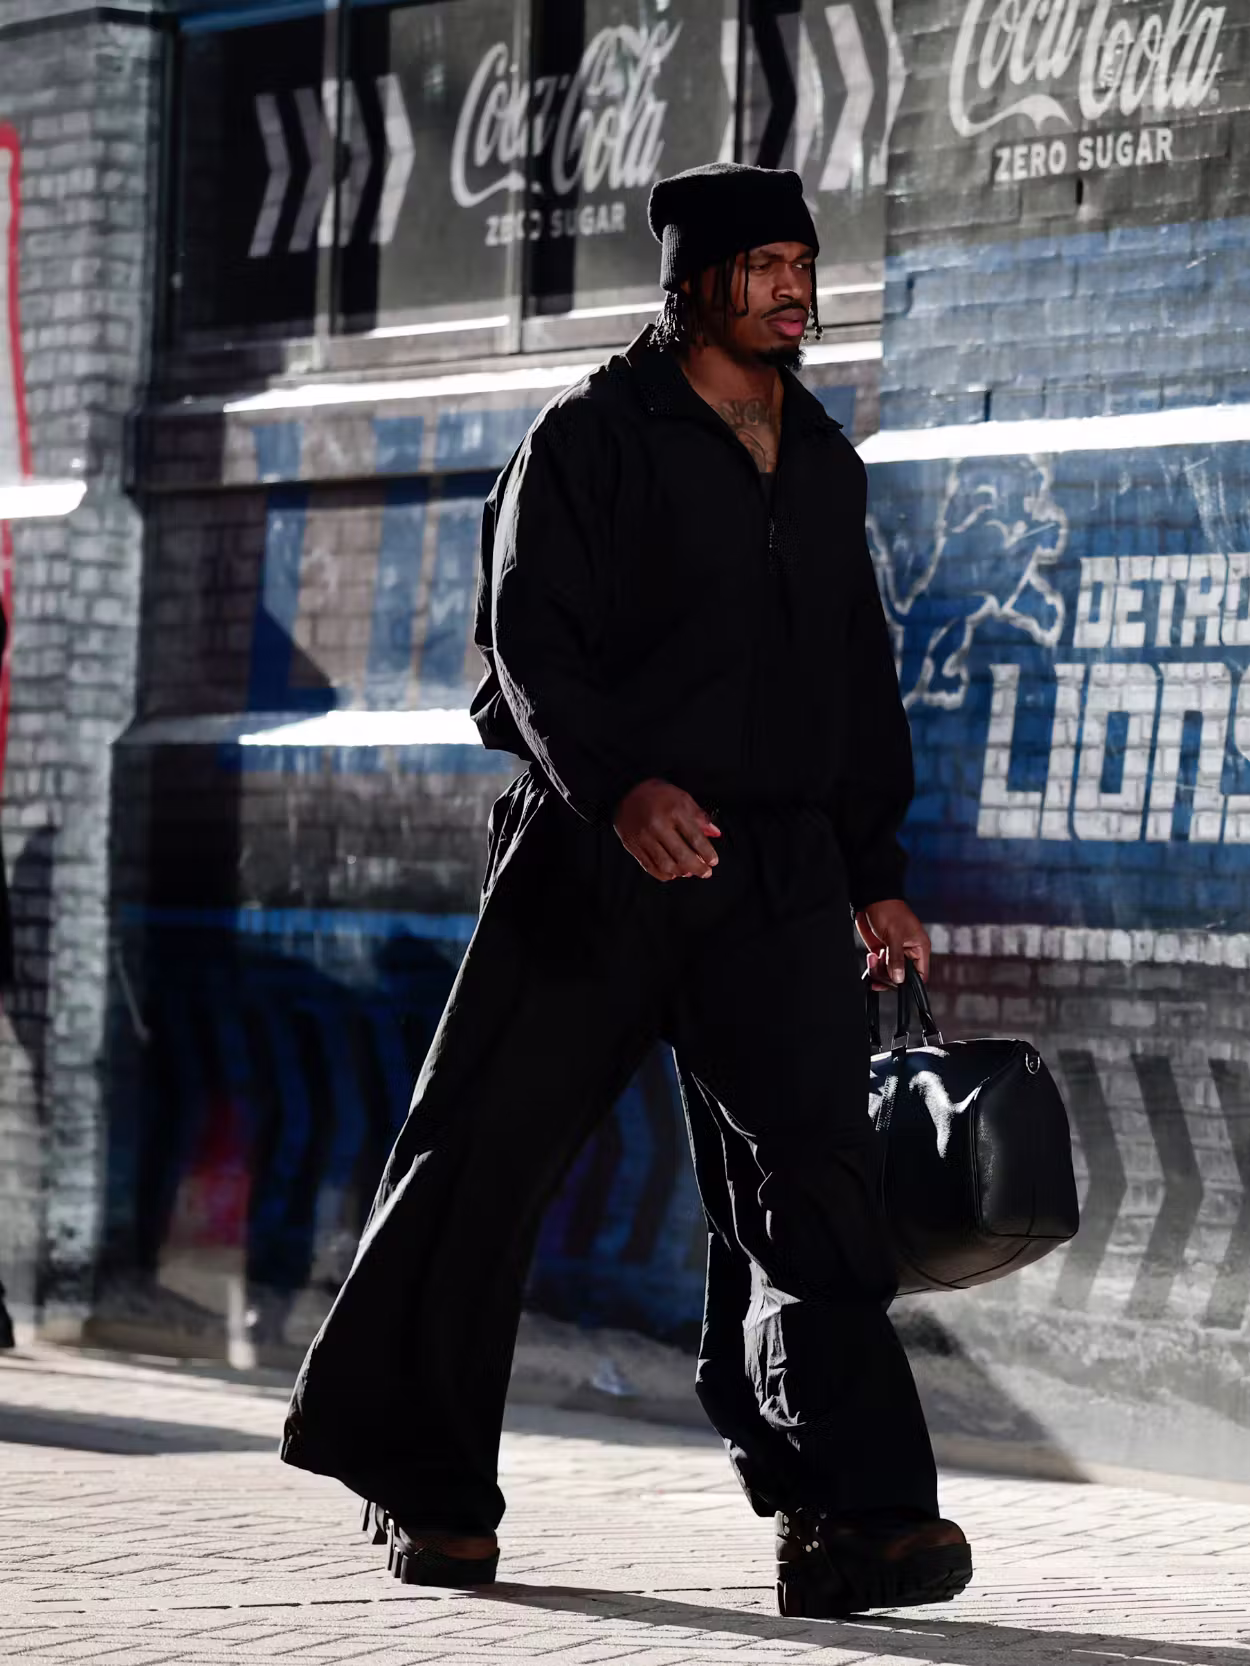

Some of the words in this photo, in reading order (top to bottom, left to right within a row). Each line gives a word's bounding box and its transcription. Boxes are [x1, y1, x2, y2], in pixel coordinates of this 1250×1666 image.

[994, 140, 1067, 182] ZERO
[1077, 127, 1173, 172] SUGAR
[551, 203, 627, 238] SUGAR
